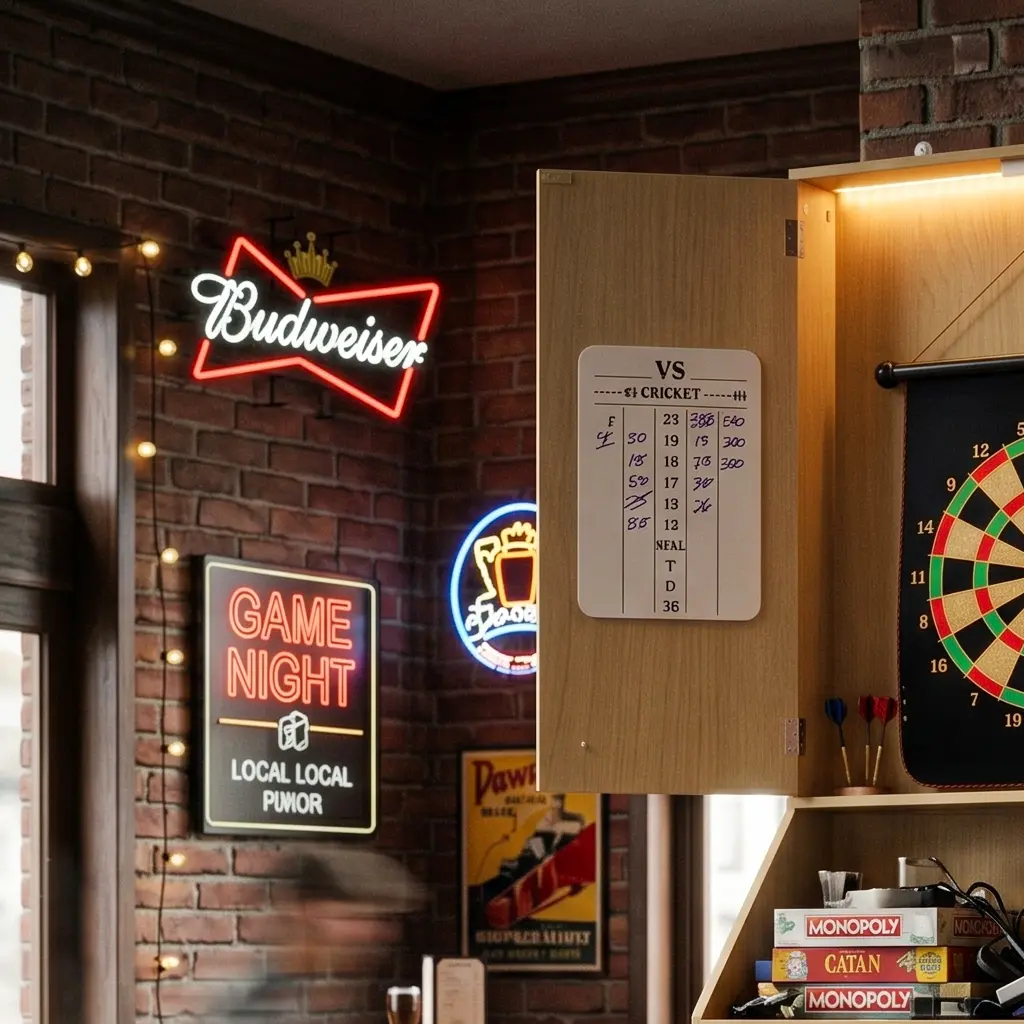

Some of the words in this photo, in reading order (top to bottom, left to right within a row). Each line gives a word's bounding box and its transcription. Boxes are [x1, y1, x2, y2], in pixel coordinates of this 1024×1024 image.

[191, 273, 428, 369] Budweiser
[655, 360, 685, 380] VS
[641, 386, 701, 400] CRICKET
[663, 413, 679, 425] 23
[664, 434, 679, 446] 19
[972, 443, 989, 458] 12
[664, 455, 679, 467] 18
[664, 477, 679, 488] 17
[946, 477, 956, 491] 9
[664, 498, 679, 509] 13
[664, 519, 679, 530] 12
[916, 520, 934, 534] 14
[665, 560, 676, 572] T
[910, 571, 926, 585] 11
[665, 580, 676, 592] D
[663, 600, 679, 612] 36
[228, 587, 352, 650] GAME
[919, 614, 929, 629] 8
[930, 659, 947, 673] 16
[227, 647, 356, 707] NIGHT
[971, 693, 979, 706] 7
[1005, 713, 1022, 727] 19
[231, 758, 291, 784] LOCAL
[295, 763, 354, 788] LOCAL
[808, 917, 900, 936] MONOPOLY
[824, 954, 881, 974] CATAN
[808, 989, 912, 1009] MONOPOLY
